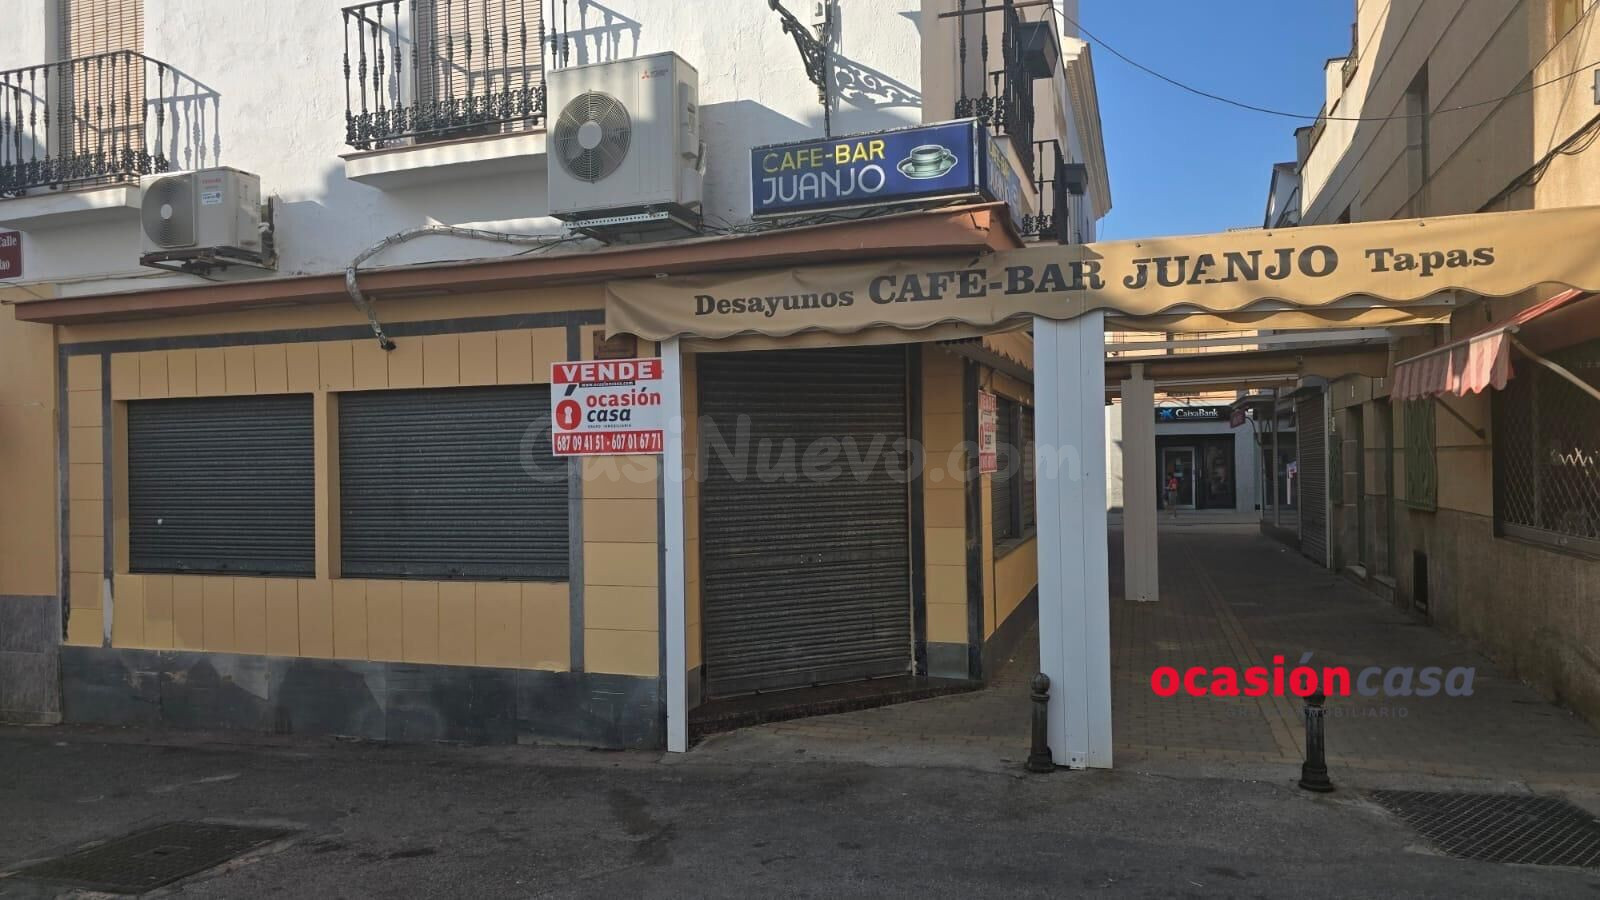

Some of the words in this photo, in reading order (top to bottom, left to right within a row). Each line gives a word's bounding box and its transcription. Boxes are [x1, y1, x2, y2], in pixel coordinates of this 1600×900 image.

[763, 140, 886, 173] CAFE-BAR
[763, 164, 886, 204] JUANJO
[694, 287, 854, 317] Desayunos
[869, 258, 1106, 305] CAFÉ-BAR
[1123, 245, 1338, 289] JUANJO
[1365, 246, 1495, 277] Tapas
[562, 361, 653, 382] VENDE
[586, 387, 661, 407] ocasión
[587, 408, 631, 422] casa
[1175, 408, 1218, 417] CaixaBank
[557, 436, 570, 451] 687
[573, 435, 582, 451] 09
[584, 435, 593, 450] 41
[595, 434, 604, 450] 51
[611, 434, 625, 450] 607
[628, 433, 637, 449] 01
[640, 433, 650, 449] 67
[652, 433, 661, 448] 71
